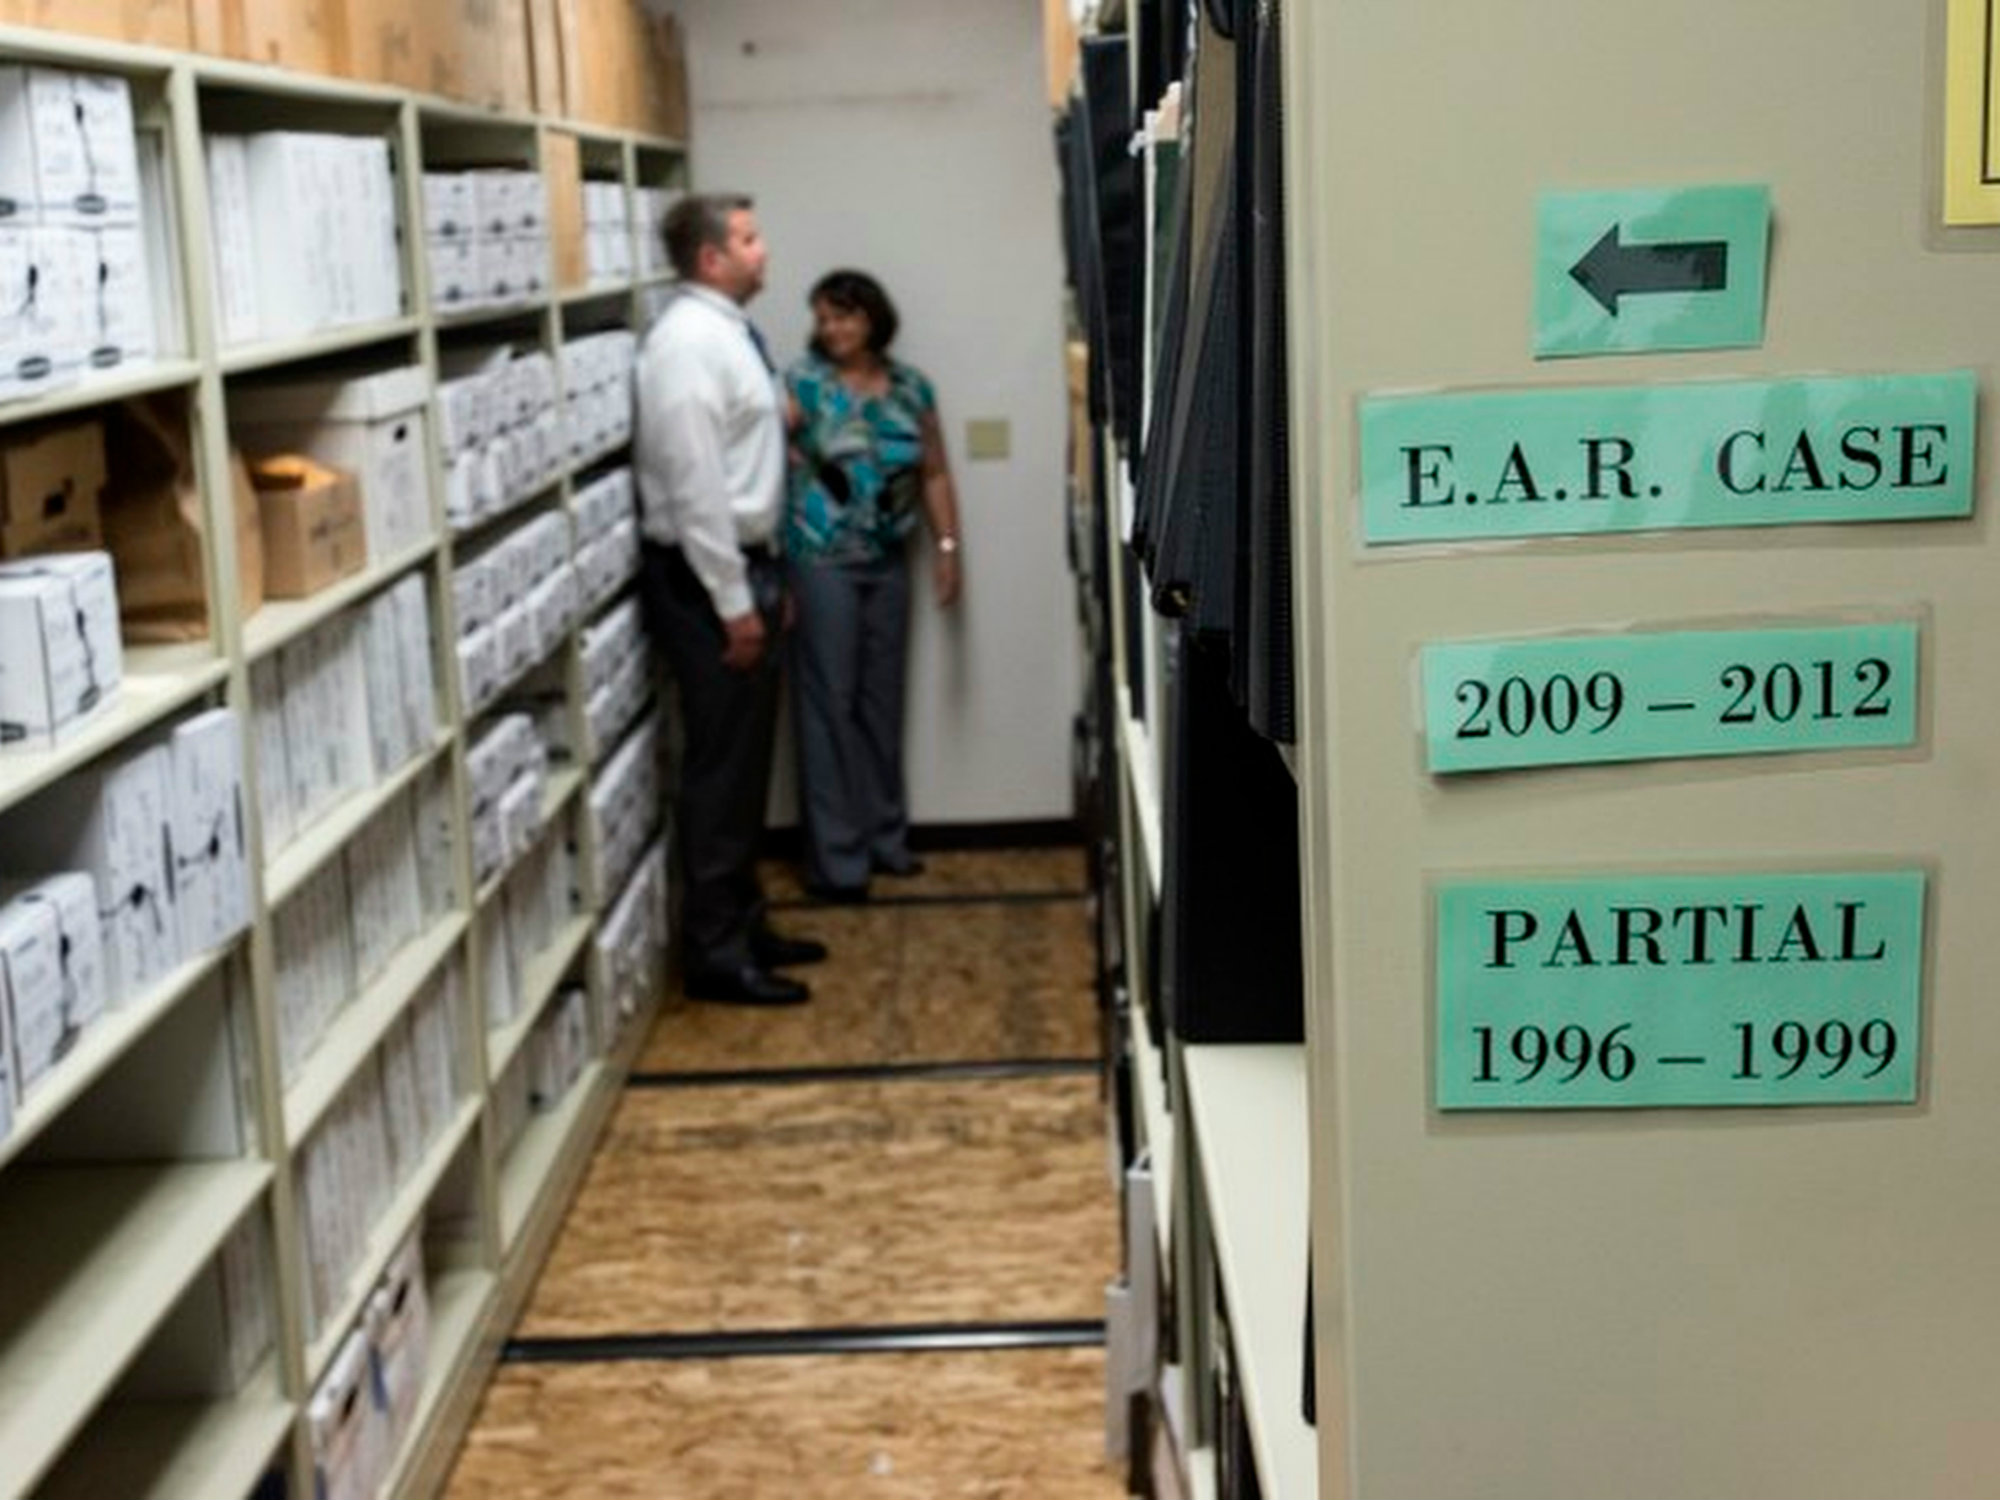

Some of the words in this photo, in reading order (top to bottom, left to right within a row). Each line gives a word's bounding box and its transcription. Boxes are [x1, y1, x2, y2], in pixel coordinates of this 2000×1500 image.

[1400, 437, 1662, 508] E.A.R.
[1717, 424, 1949, 495] CASE
[1455, 672, 1625, 740] 2009
[1719, 657, 1892, 726] 2012
[1484, 901, 1886, 969] PARTIAL
[1472, 1022, 1637, 1085] 1996
[1731, 1018, 1898, 1081] 1999
